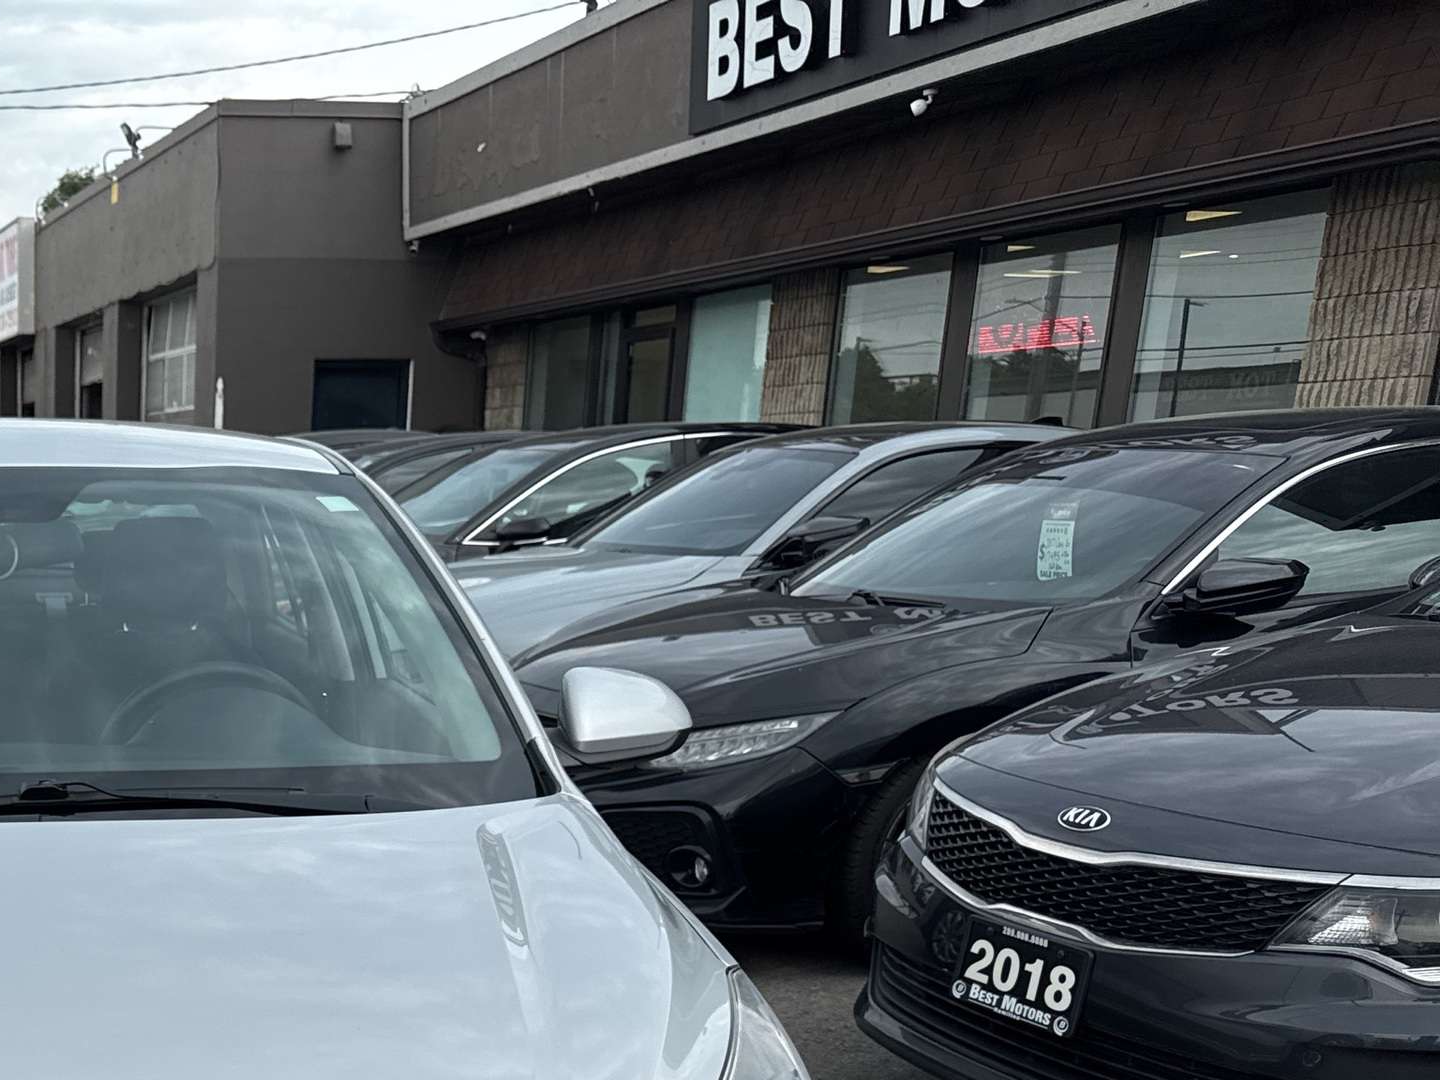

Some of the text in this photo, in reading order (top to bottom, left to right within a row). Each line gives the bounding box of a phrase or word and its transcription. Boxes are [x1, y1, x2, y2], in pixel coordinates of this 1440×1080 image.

[1062, 807, 1101, 827] KIA
[963, 939, 1076, 1012] 2018
[968, 983, 1051, 1026] BEST MOTORS
